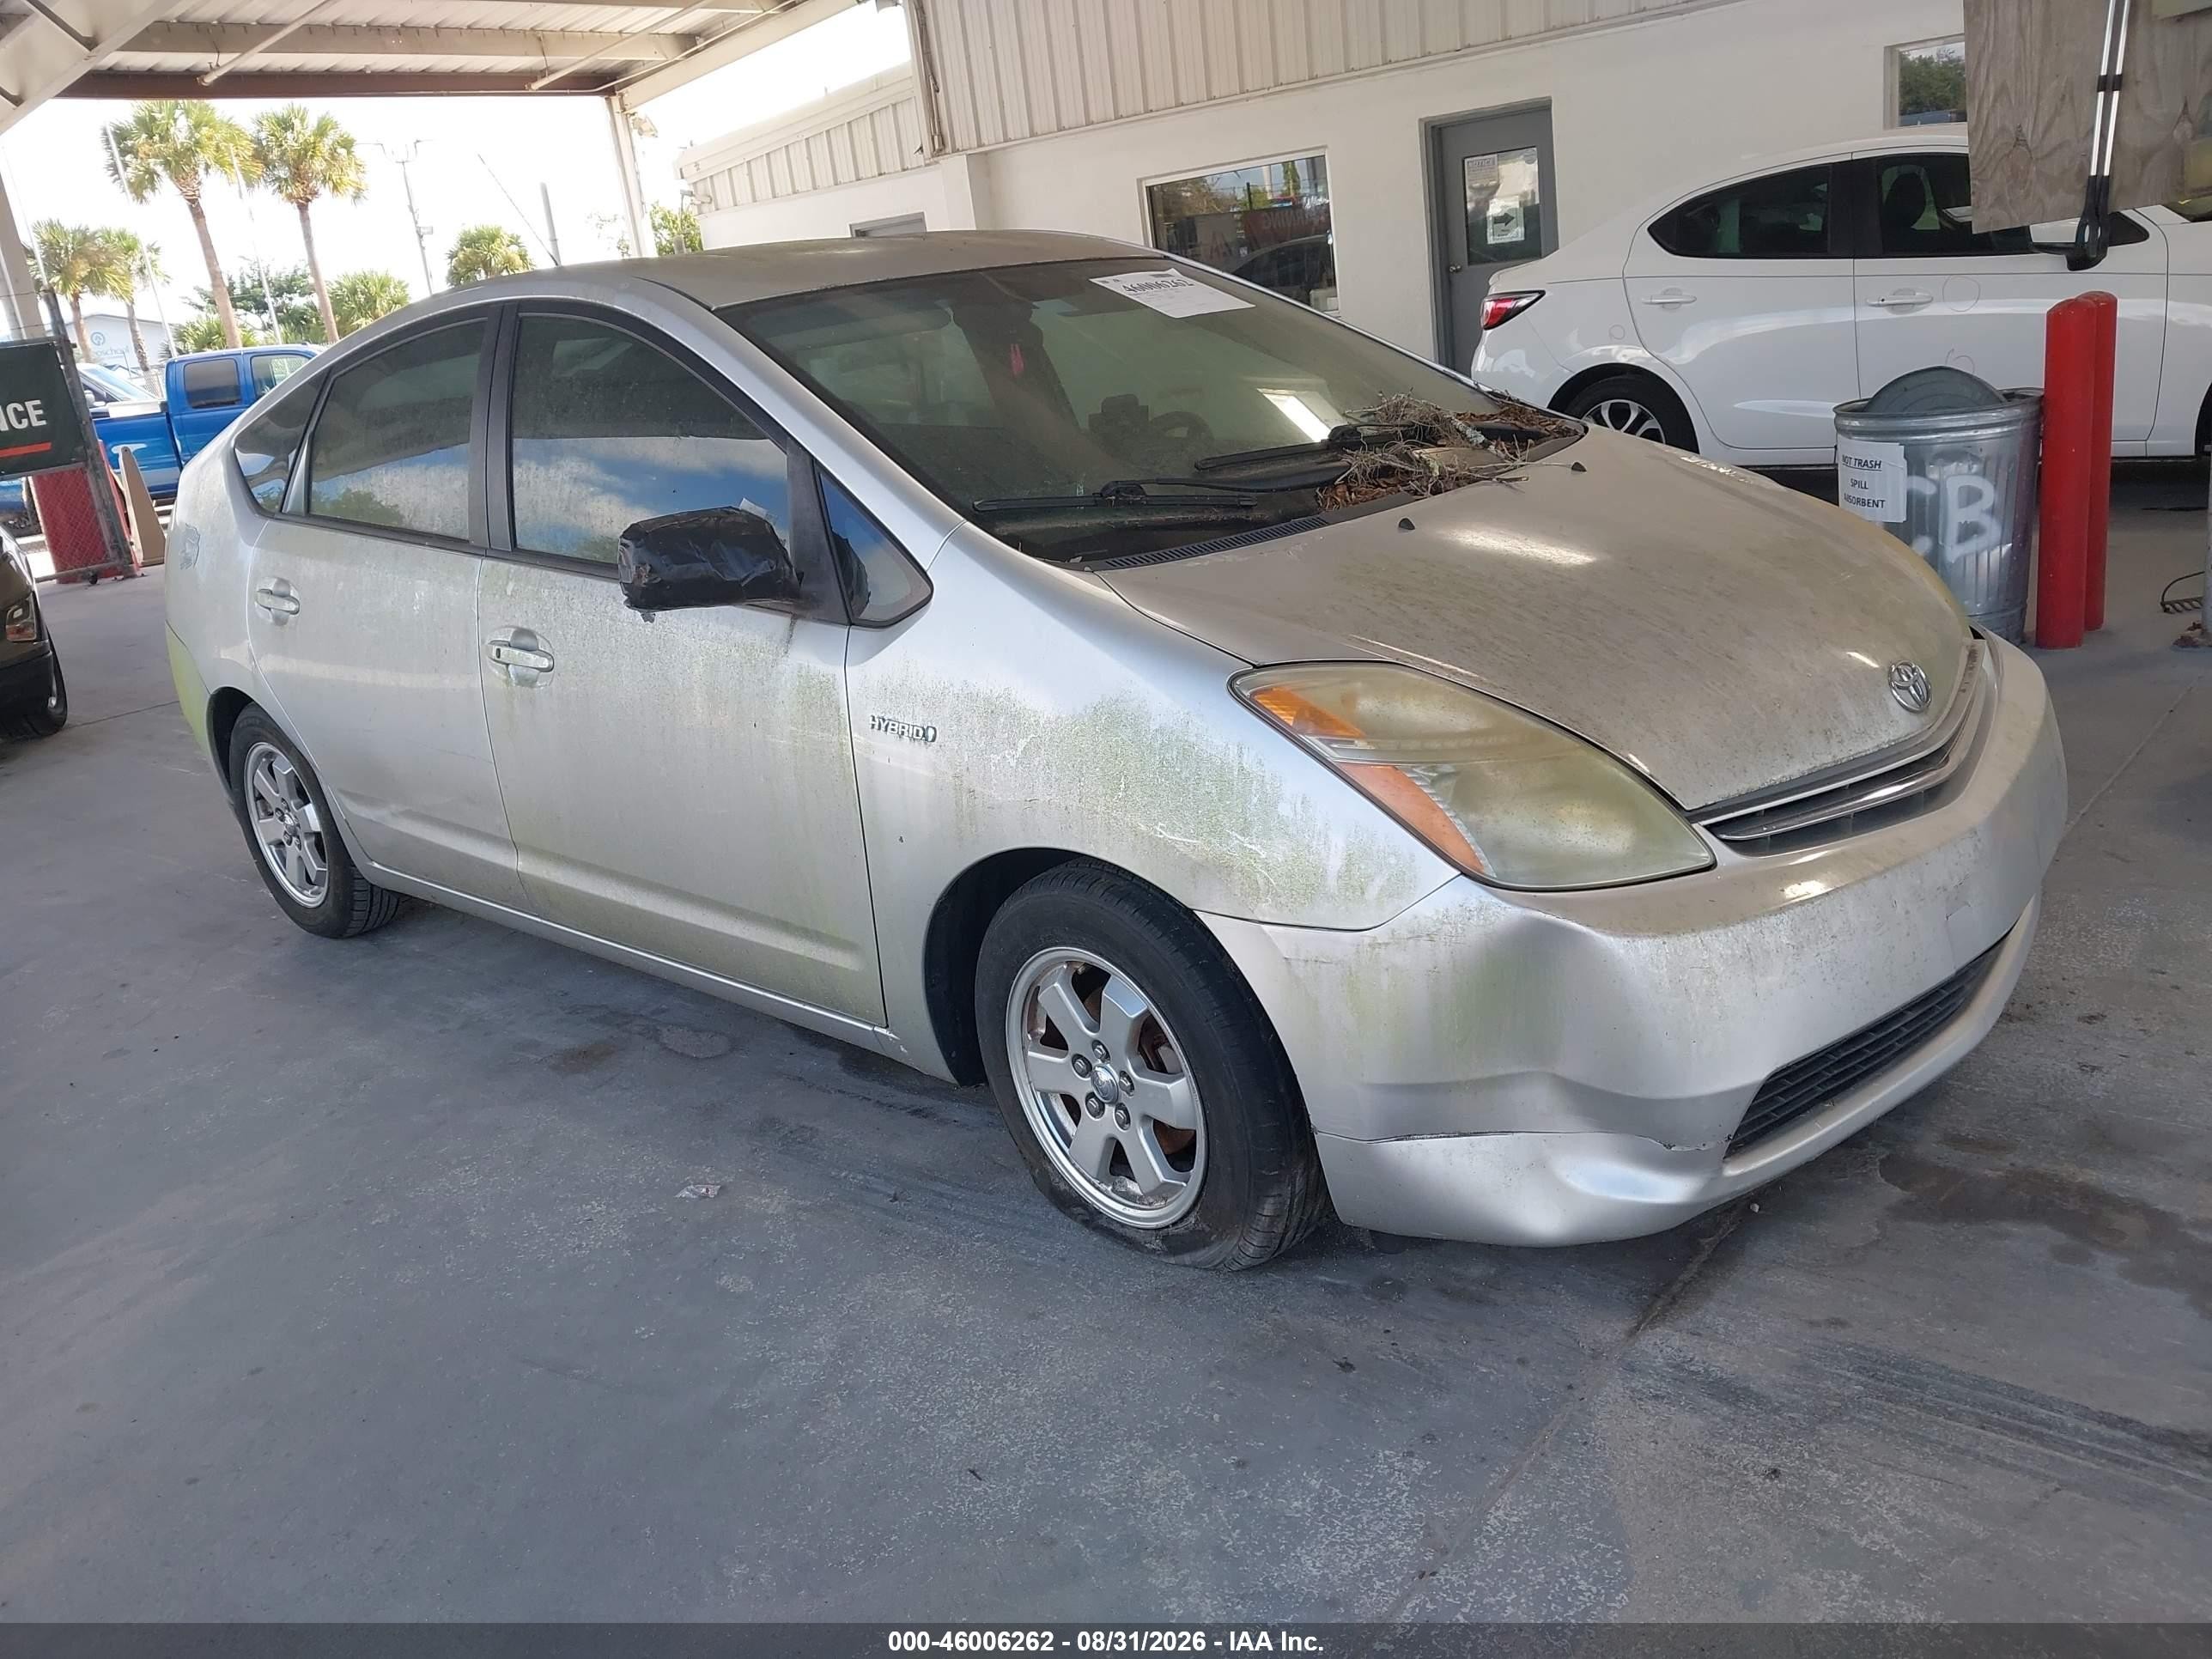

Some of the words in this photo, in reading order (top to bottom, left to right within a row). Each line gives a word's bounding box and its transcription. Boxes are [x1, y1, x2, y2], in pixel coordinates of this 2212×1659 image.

[1122, 279, 1195, 294] 46006262
[1842, 454, 1852, 465] NOT
[1853, 458, 1882, 470] TRASH
[1850, 478, 1869, 490] SPILL
[869, 714, 925, 740] HYBRID
